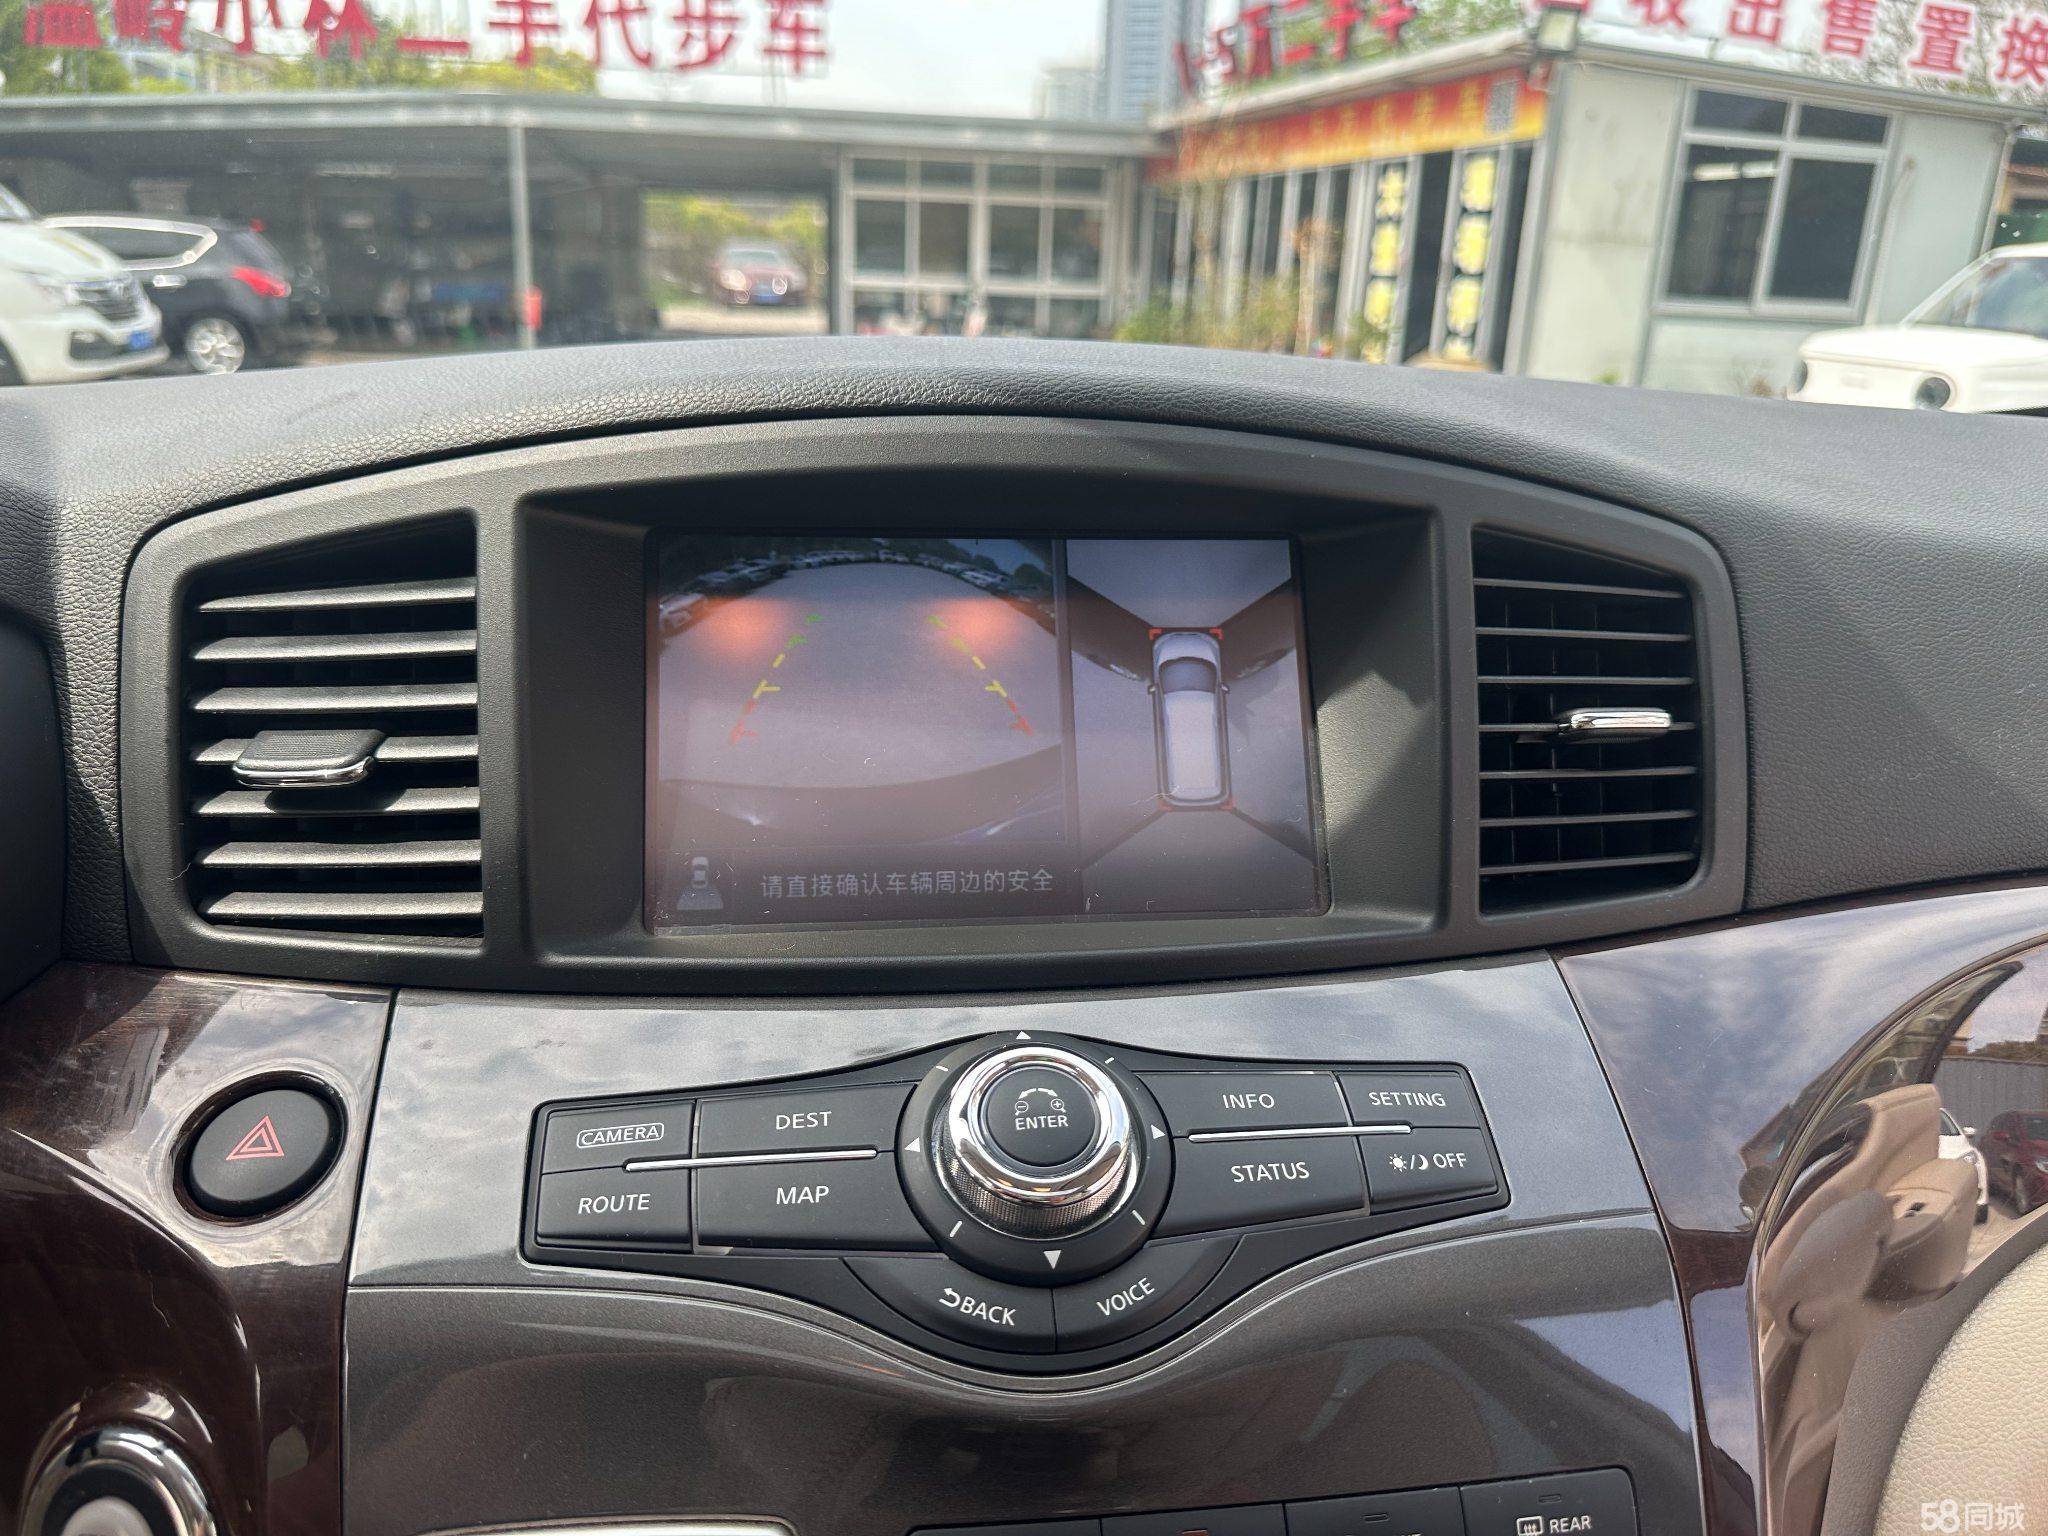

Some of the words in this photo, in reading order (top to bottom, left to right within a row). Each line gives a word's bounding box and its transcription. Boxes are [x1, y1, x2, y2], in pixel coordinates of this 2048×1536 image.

[760, 868, 1053, 899] 请直接确认车辆周边的安全
[1222, 1093, 1276, 1110] INFO
[1368, 1091, 1447, 1109] SETTING
[775, 1111, 832, 1130] DEST
[1015, 1114, 1068, 1131] ENTER
[580, 1125, 660, 1146] CAMERA
[1433, 1152, 1467, 1170] OFF
[1231, 1161, 1310, 1183] STATUS
[577, 1193, 651, 1214] ROUTE
[776, 1186, 830, 1205] MAP
[1097, 1277, 1155, 1317] VOICE
[958, 1295, 1017, 1327] BACK
[1549, 1515, 1593, 1534] REAR
